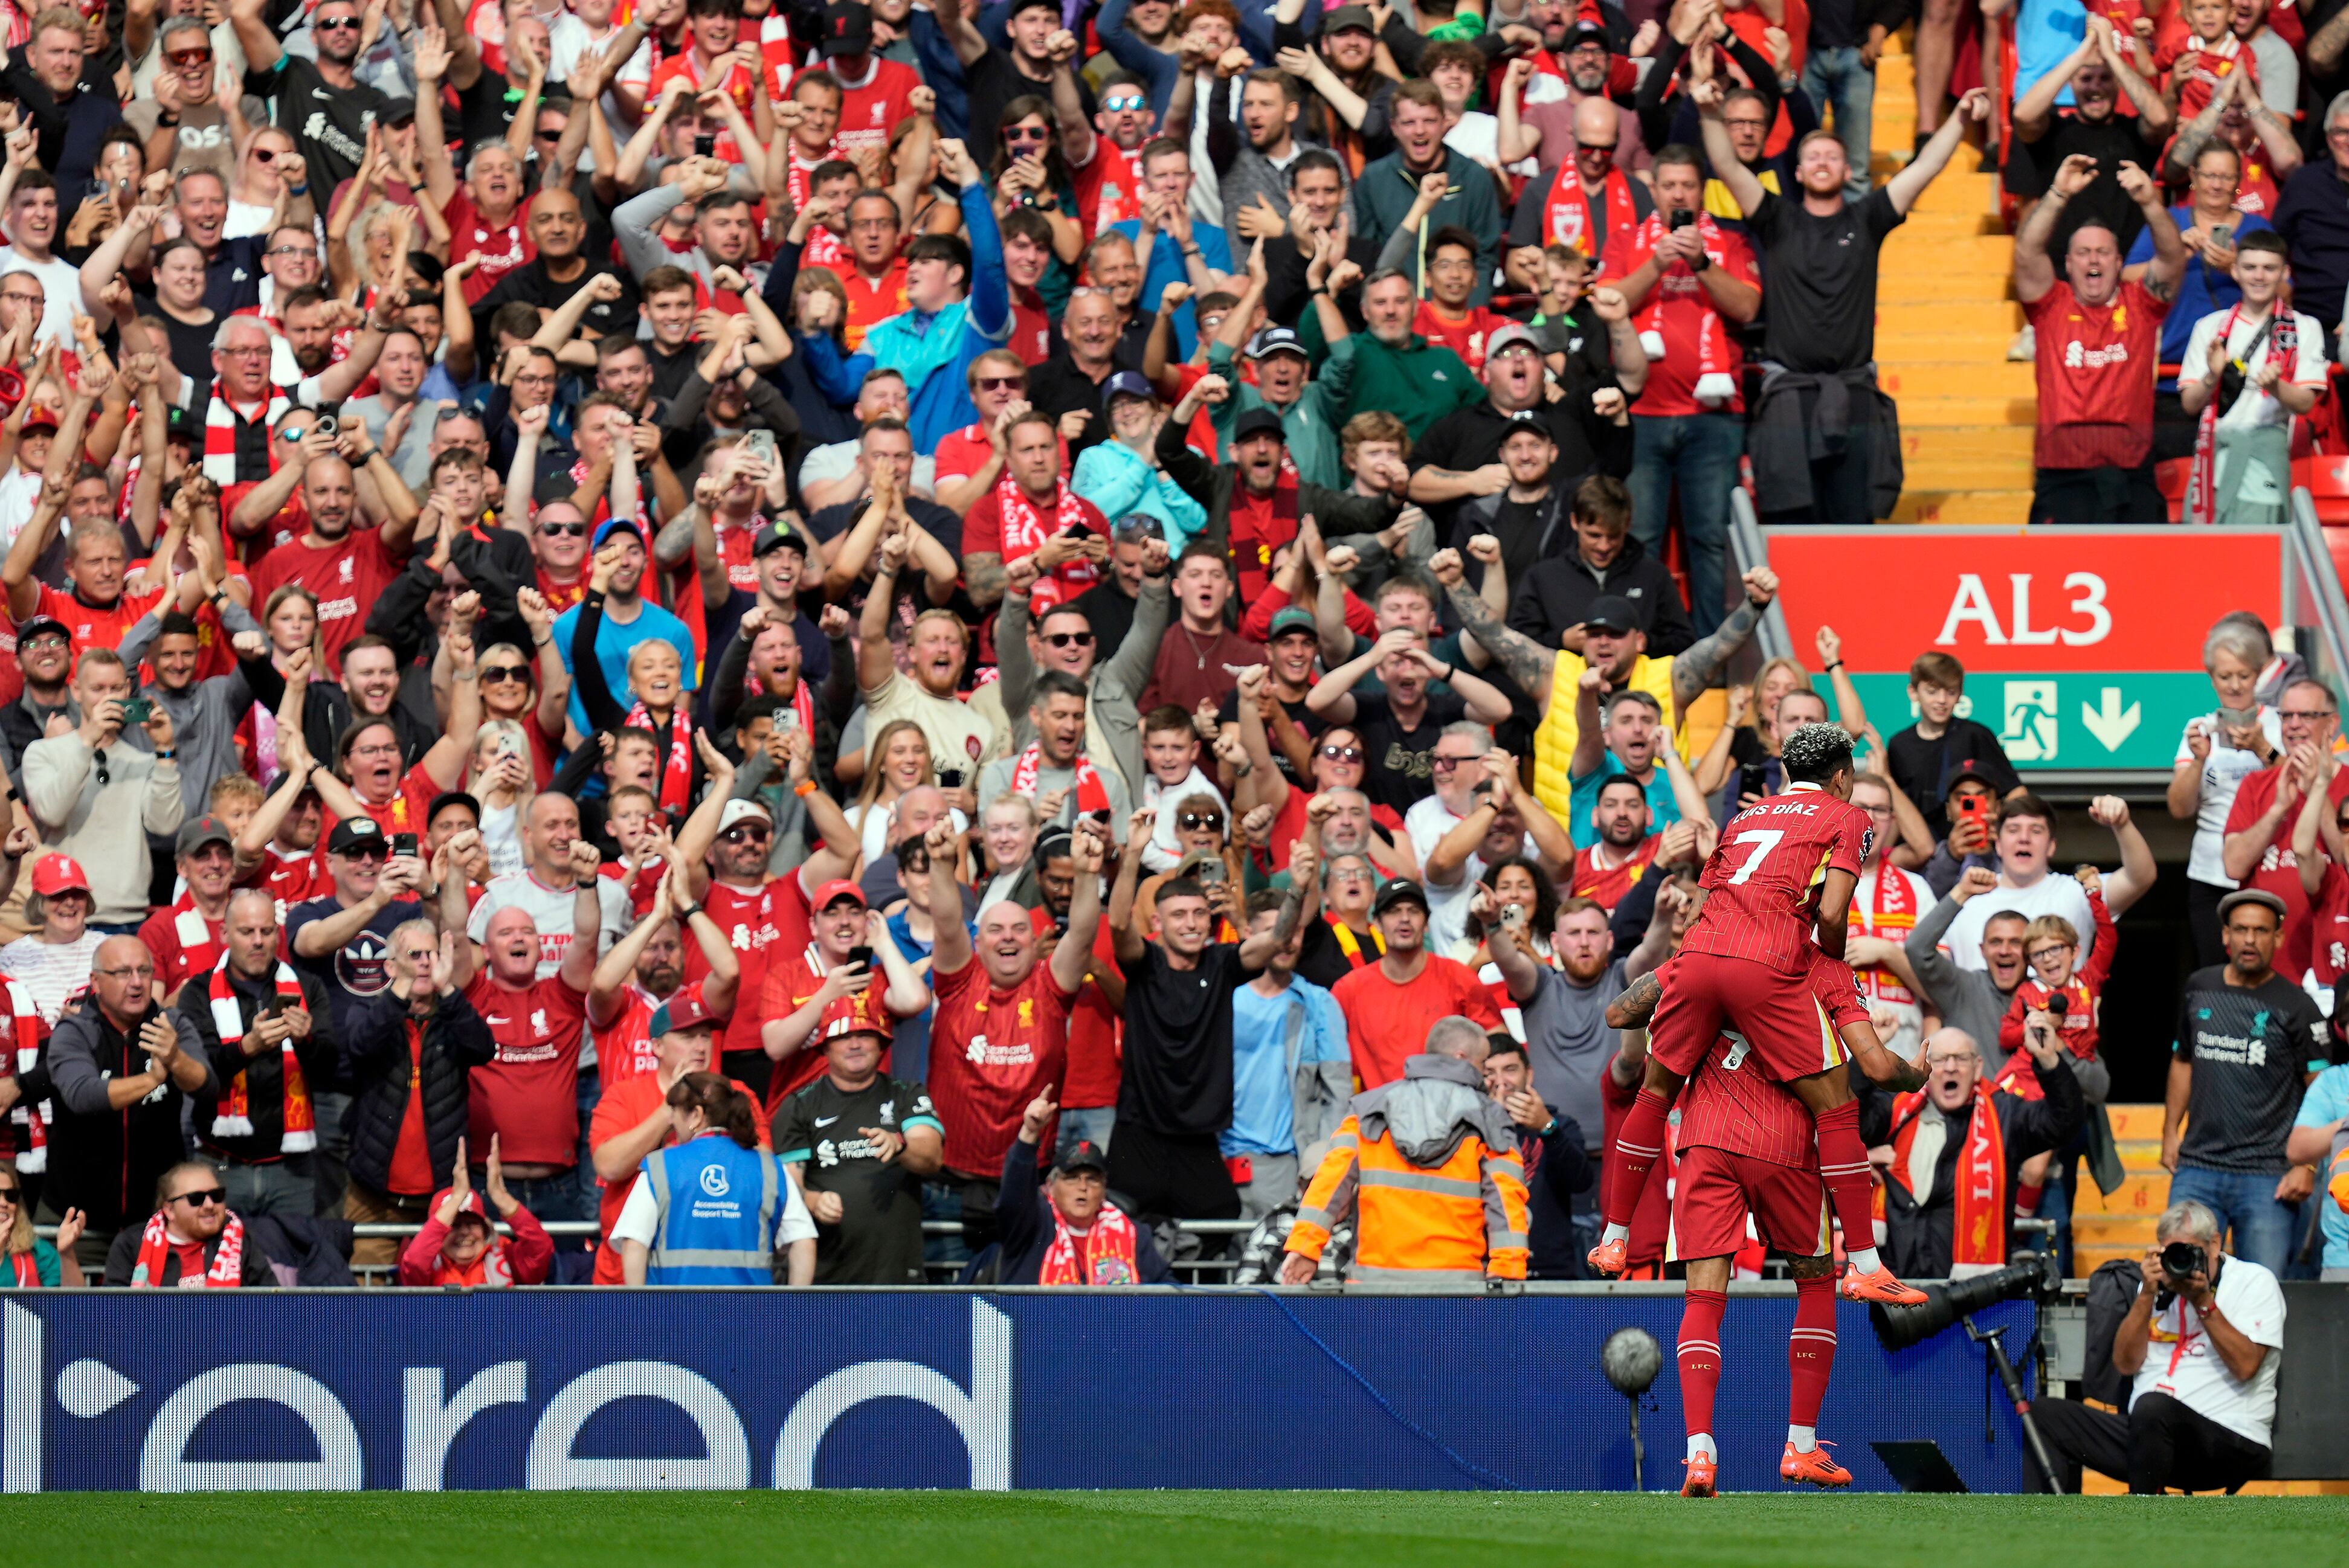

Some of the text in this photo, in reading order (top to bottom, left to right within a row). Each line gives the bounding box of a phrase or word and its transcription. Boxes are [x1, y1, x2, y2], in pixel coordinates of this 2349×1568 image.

[1935, 571, 2113, 646] AL3
[1732, 801, 1820, 825] LUIS DÍAZ
[1727, 829, 1785, 885] 7
[2197, 1030, 2249, 1051] Standard
[2195, 1044, 2248, 1064] Chartered
[692, 1209, 742, 1219] Support Team
[694, 1200, 740, 1211] Accessibility
